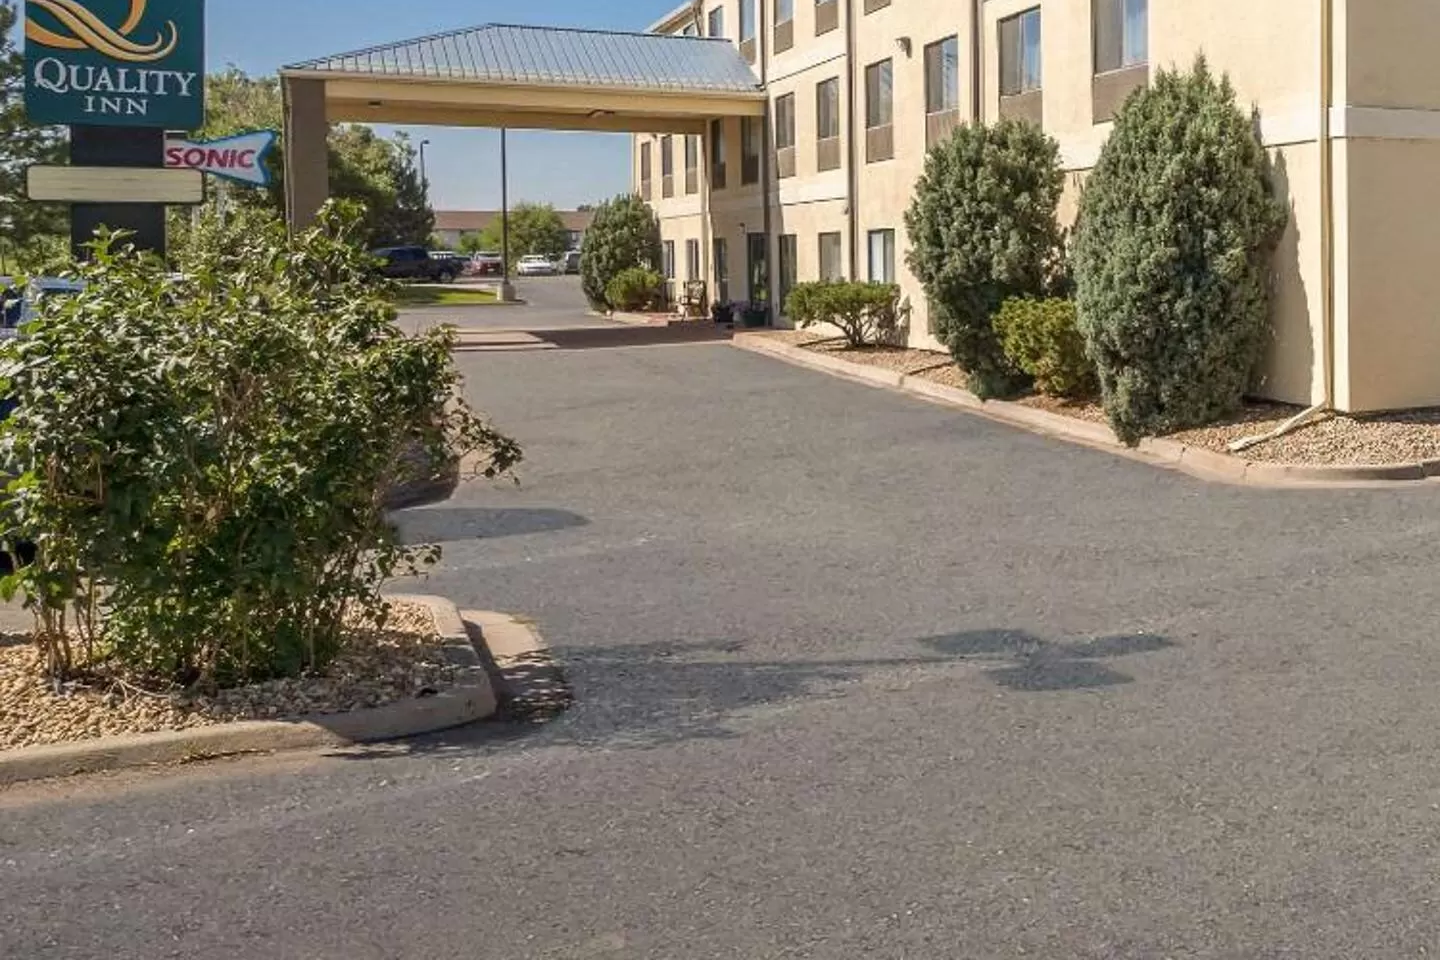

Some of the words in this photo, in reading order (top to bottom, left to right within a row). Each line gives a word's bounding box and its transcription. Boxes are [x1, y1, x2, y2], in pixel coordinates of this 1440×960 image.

[34, 57, 196, 96] QUALITY
[83, 96, 148, 115] INN
[166, 147, 255, 168] SONIC
